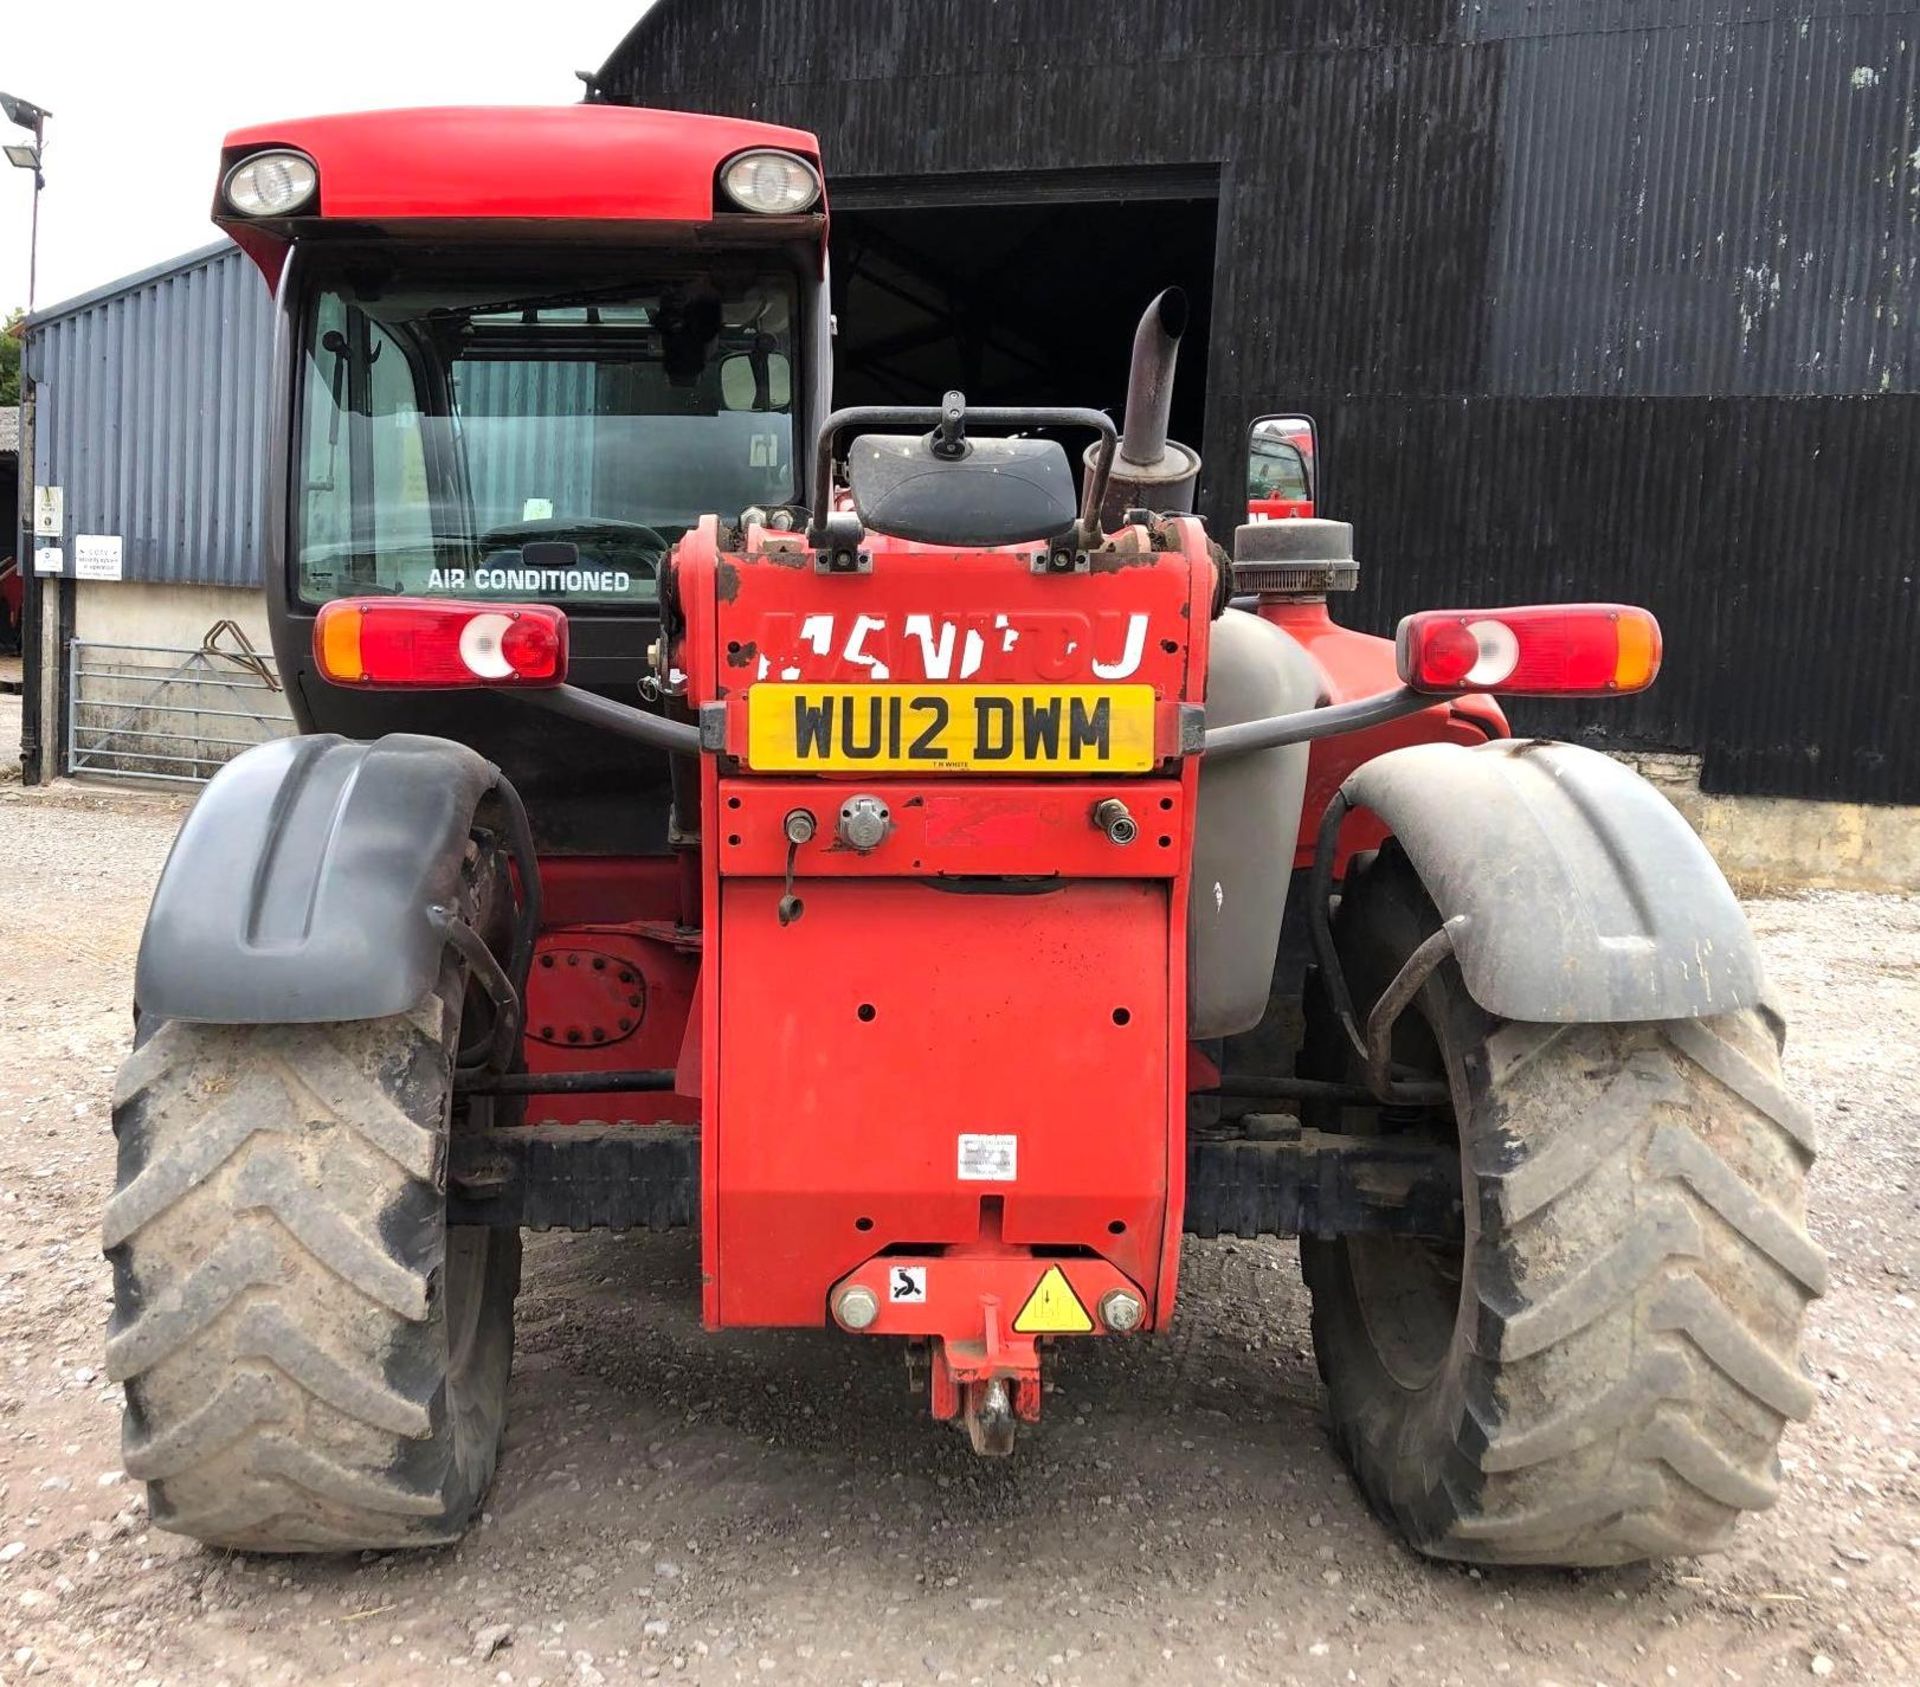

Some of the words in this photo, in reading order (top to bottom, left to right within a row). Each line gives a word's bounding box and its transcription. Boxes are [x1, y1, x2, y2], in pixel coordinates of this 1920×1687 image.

[428, 569, 465, 589] AIR
[474, 569, 630, 592] CONDITIONED
[756, 613, 1150, 680] MANIU
[795, 695, 949, 760] WU12
[973, 696, 1111, 761] DWM
